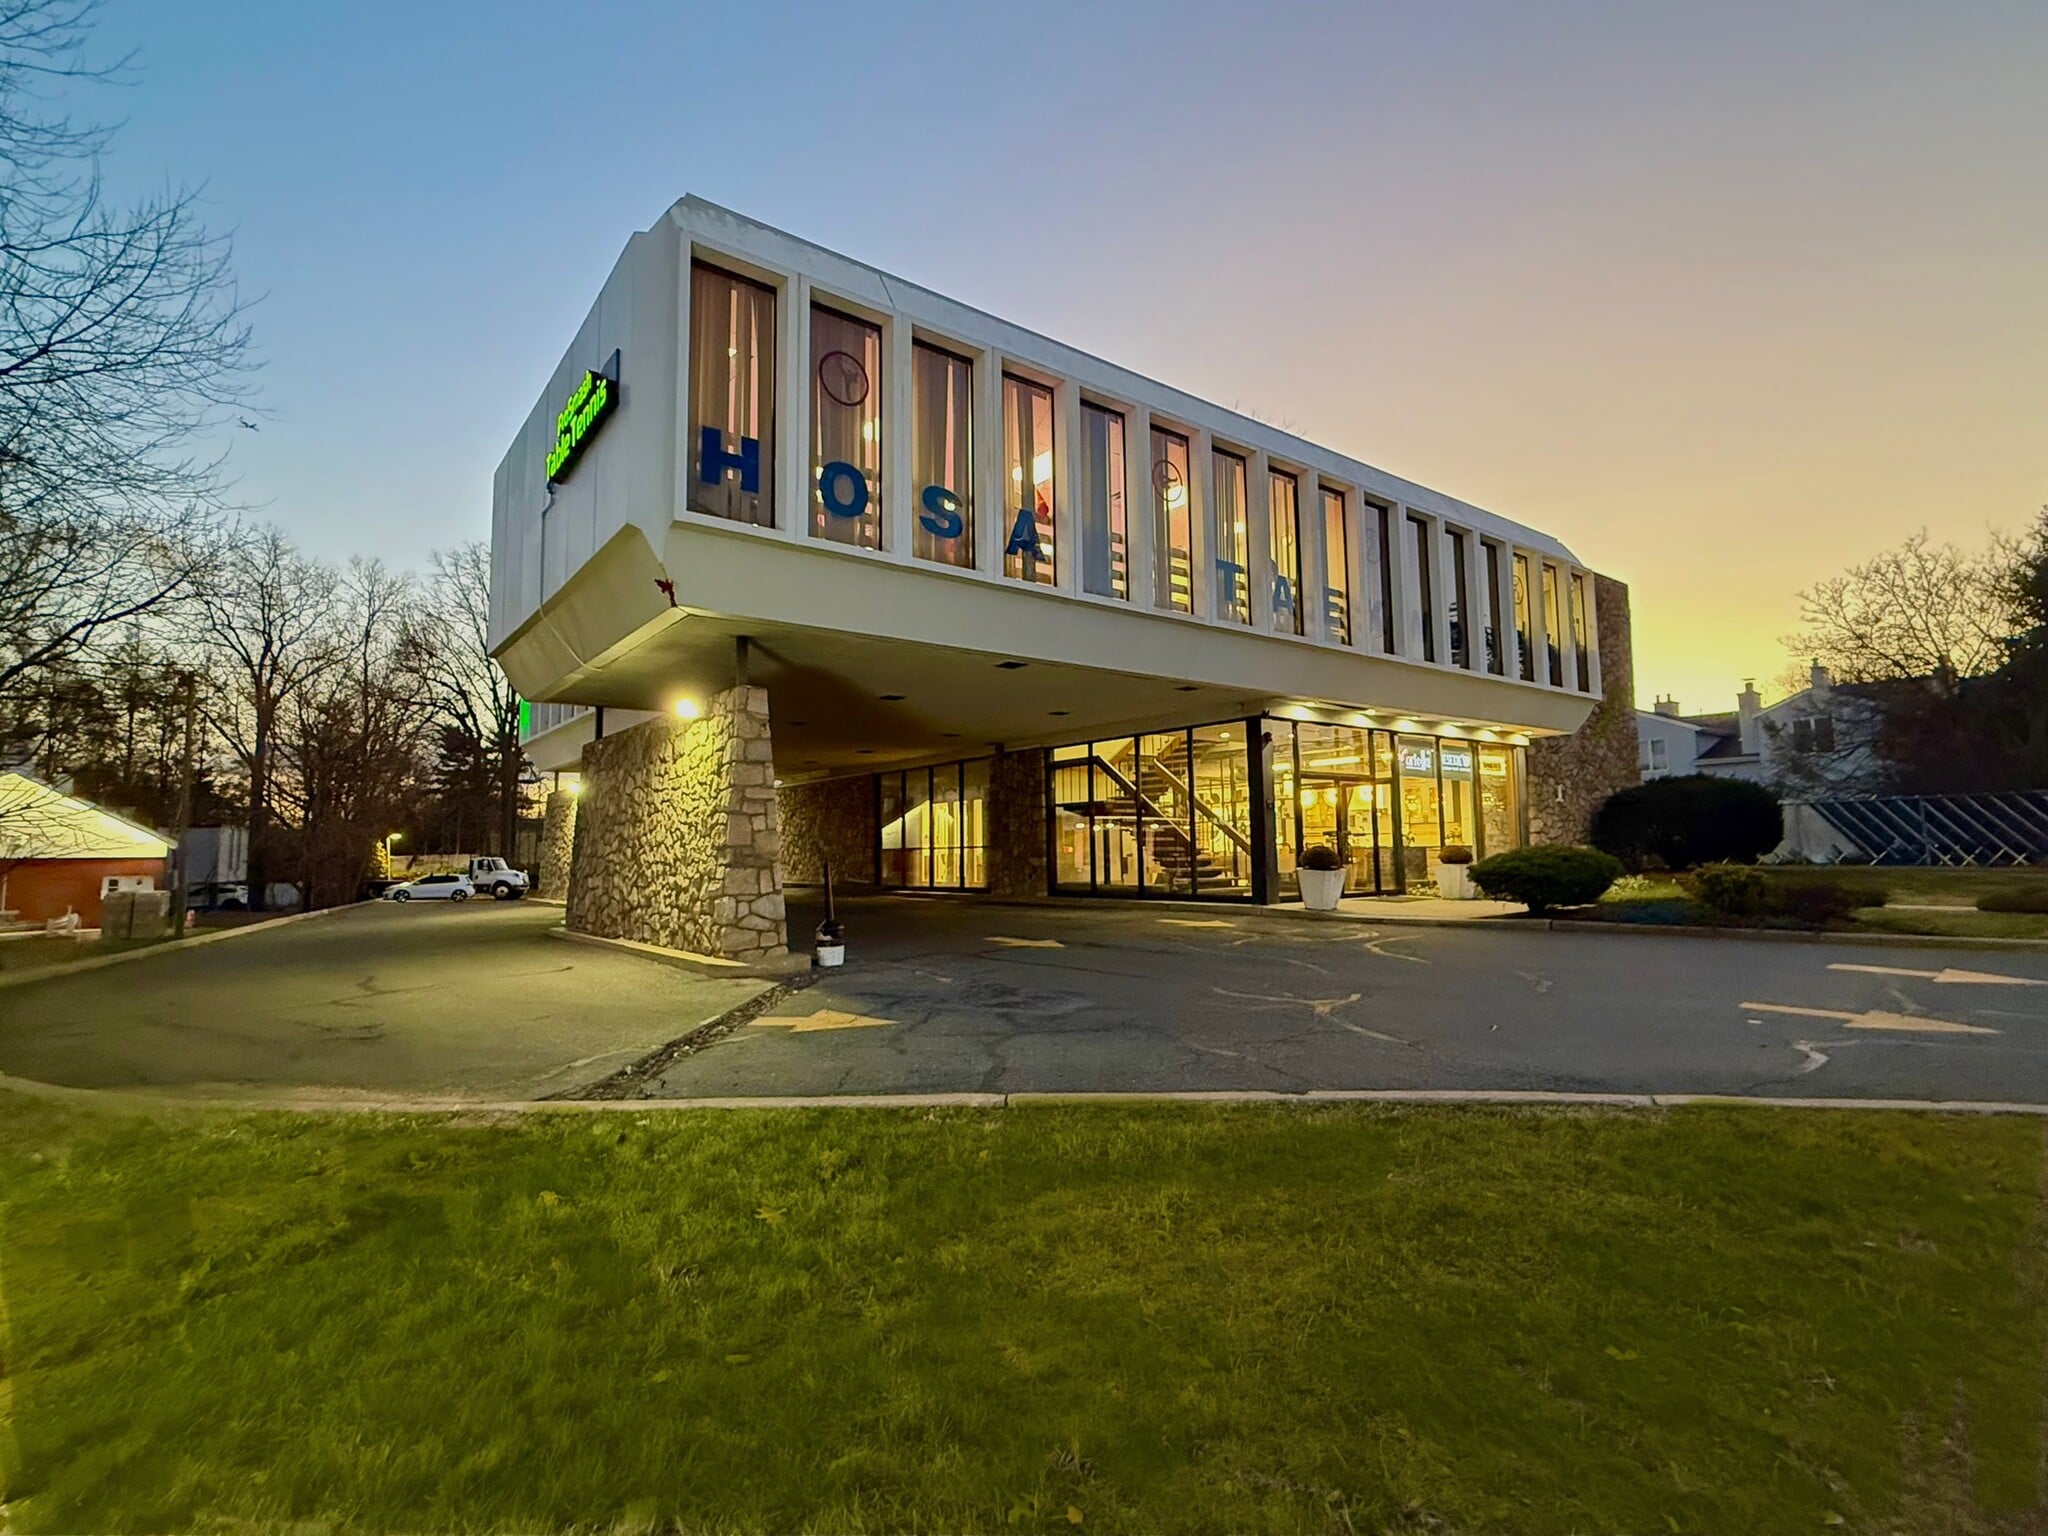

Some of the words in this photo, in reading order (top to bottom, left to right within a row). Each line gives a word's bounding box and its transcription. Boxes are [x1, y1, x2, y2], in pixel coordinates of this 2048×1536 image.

[546, 432, 571, 482] Table
[570, 378, 607, 447] Tennis
[701, 425, 1046, 562] HOSA
